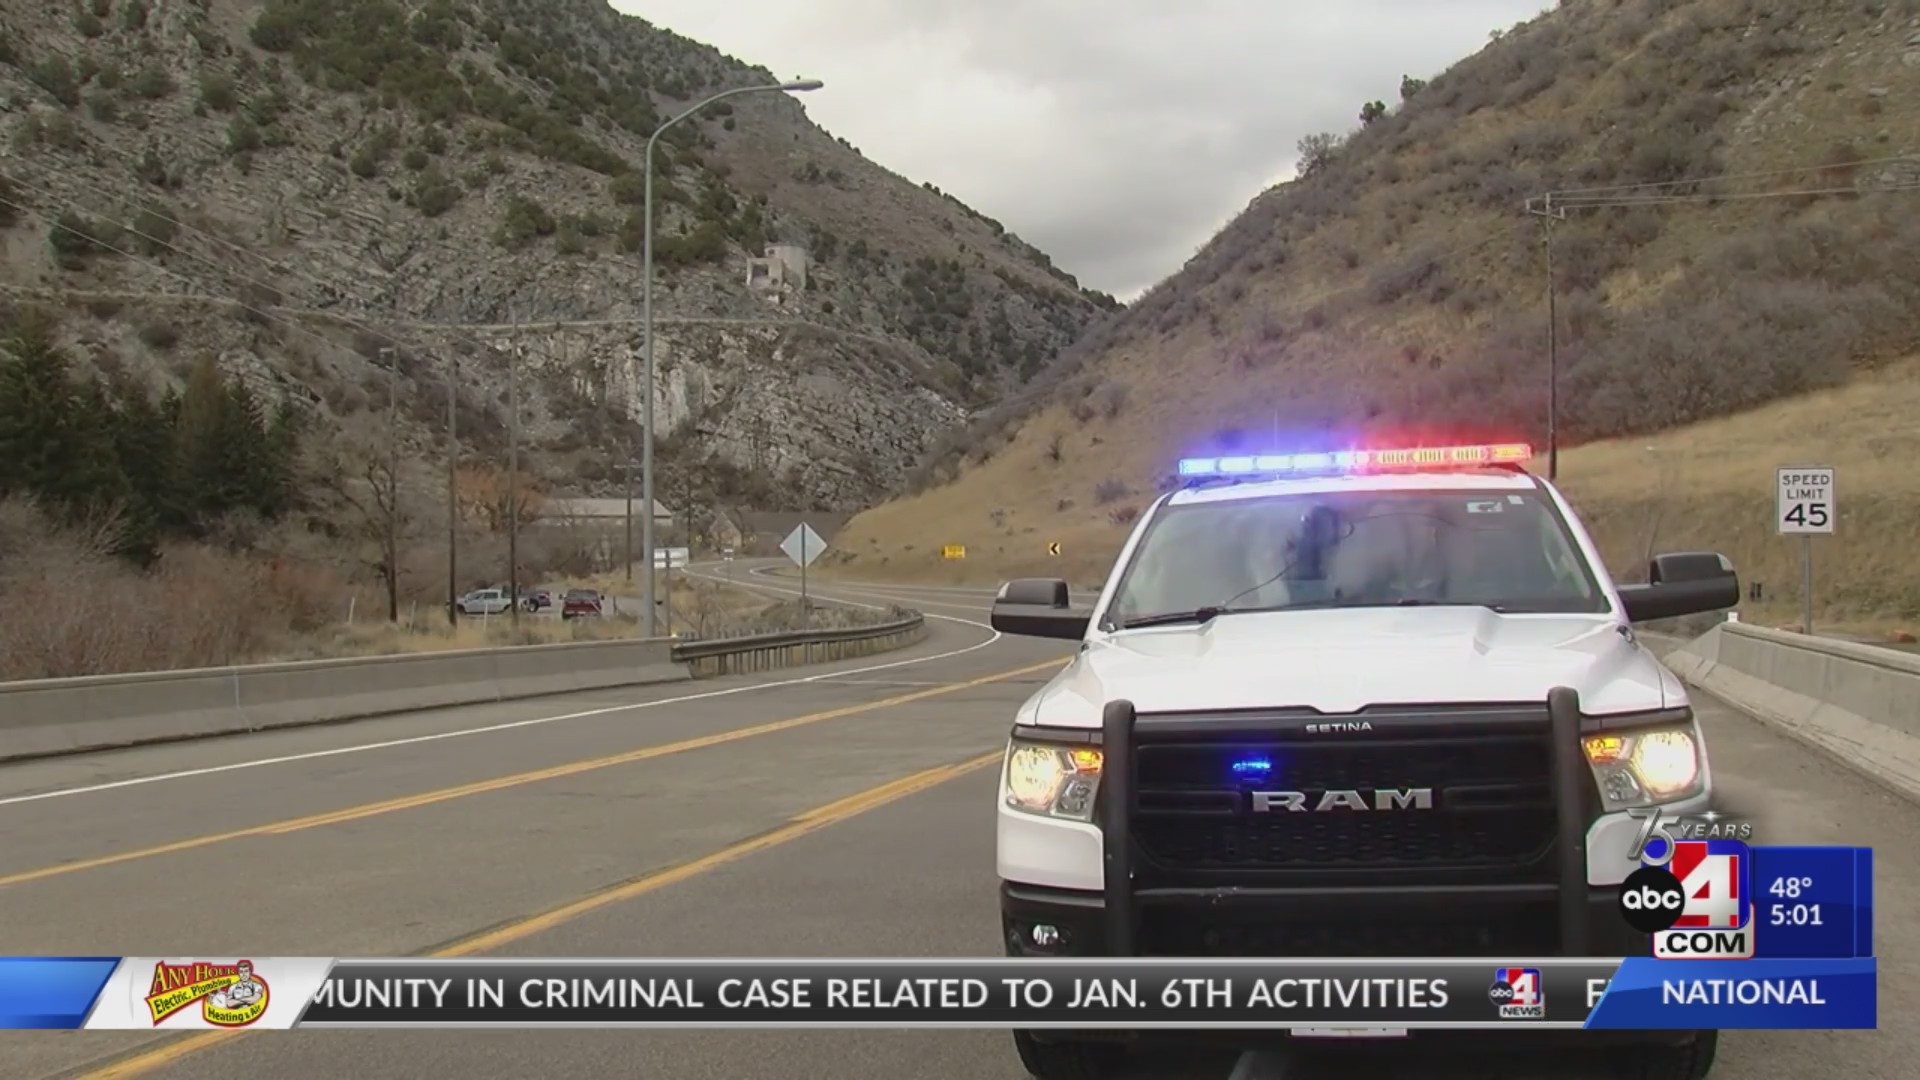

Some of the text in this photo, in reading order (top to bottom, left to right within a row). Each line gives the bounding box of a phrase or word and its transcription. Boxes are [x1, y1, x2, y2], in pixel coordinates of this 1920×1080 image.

[1782, 474, 1830, 486] SPEED
[1786, 488, 1824, 500] LIMIT
[1784, 503, 1828, 527] 45
[1306, 721, 1373, 733] SETINA
[1252, 788, 1433, 812] RAM
